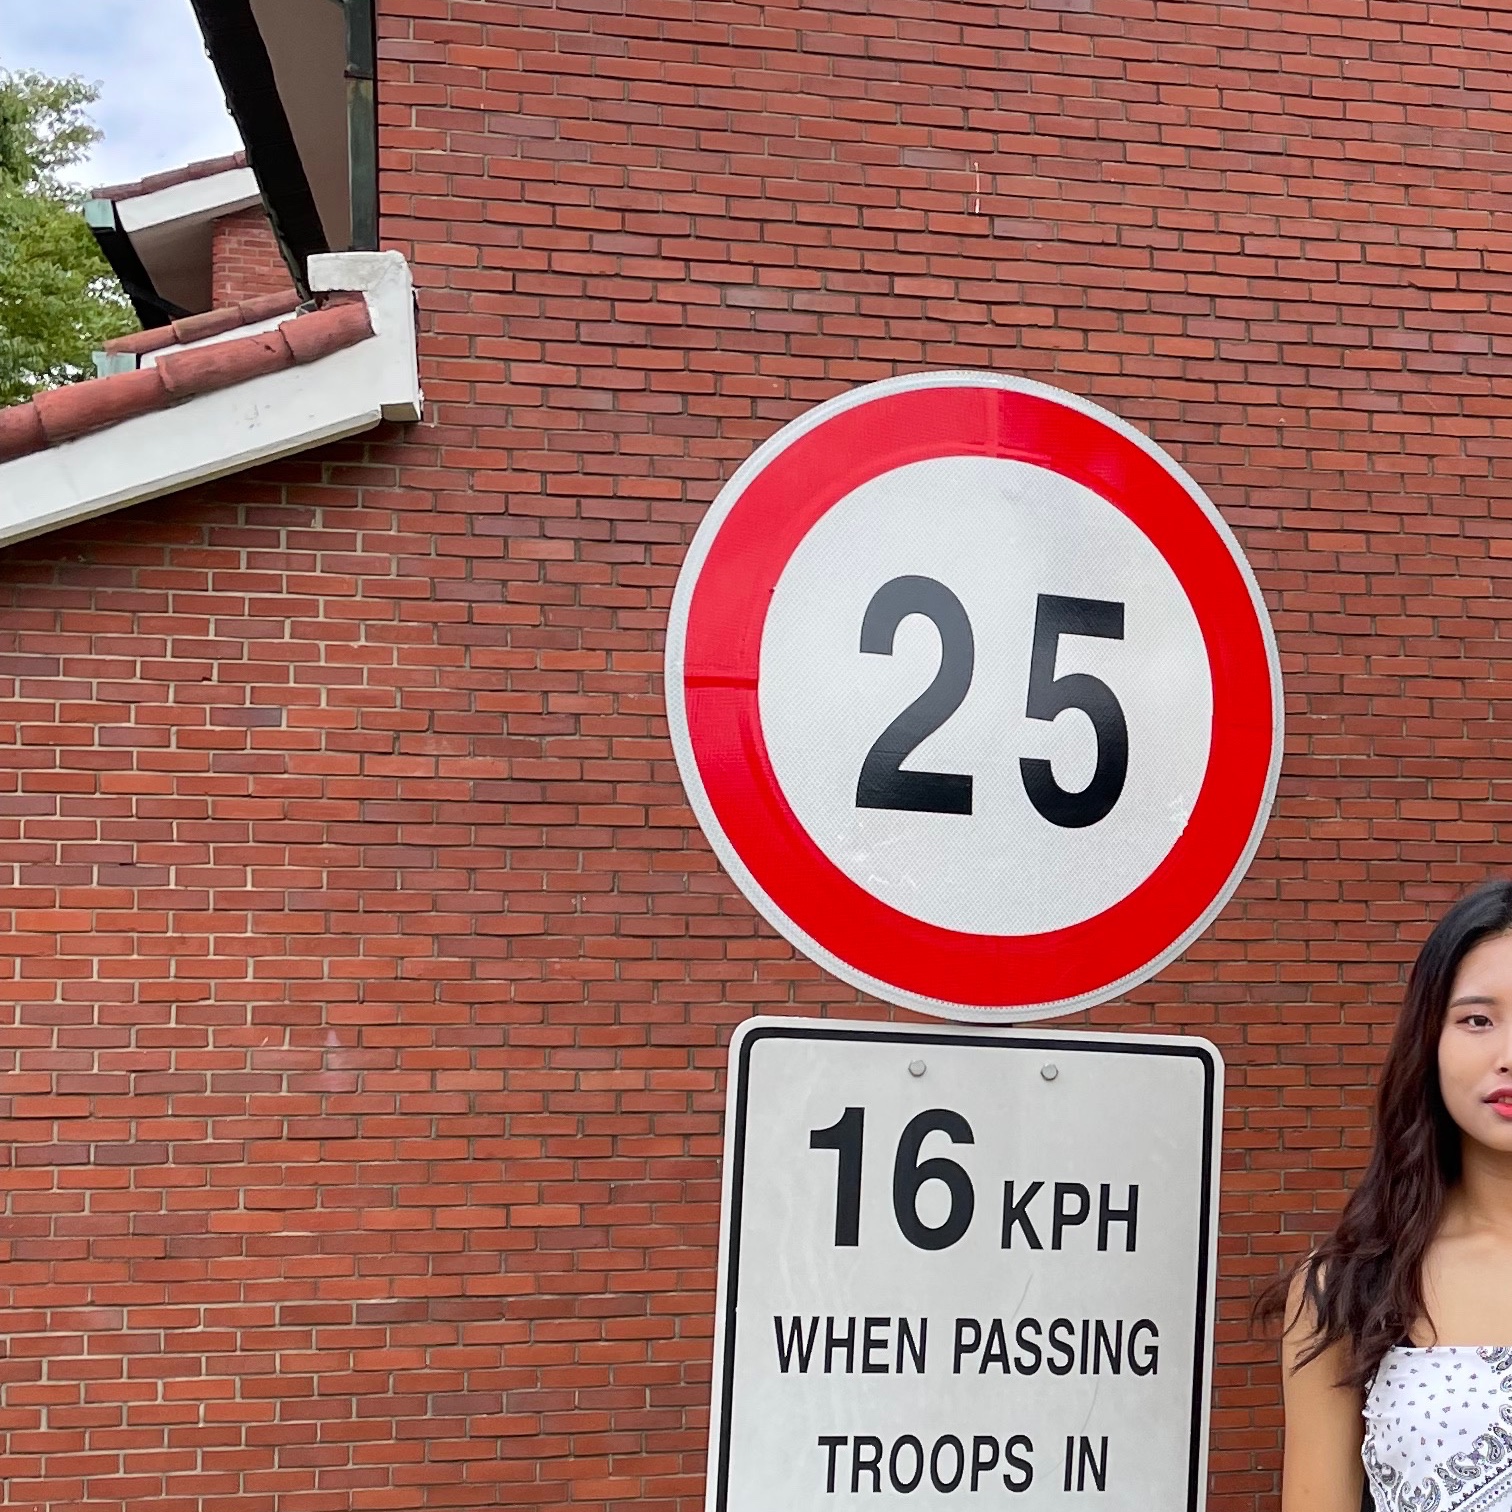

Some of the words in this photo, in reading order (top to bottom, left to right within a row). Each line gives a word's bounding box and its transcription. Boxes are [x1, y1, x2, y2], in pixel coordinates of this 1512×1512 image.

[856, 575, 1128, 828] 25
[810, 1107, 975, 1251] 16
[1001, 1180, 1139, 1252] KPH
[774, 1316, 928, 1374] WHEN
[953, 1318, 1160, 1376] PASSING
[818, 1435, 1034, 1494] TROOPS
[1064, 1435, 1108, 1492] IN
